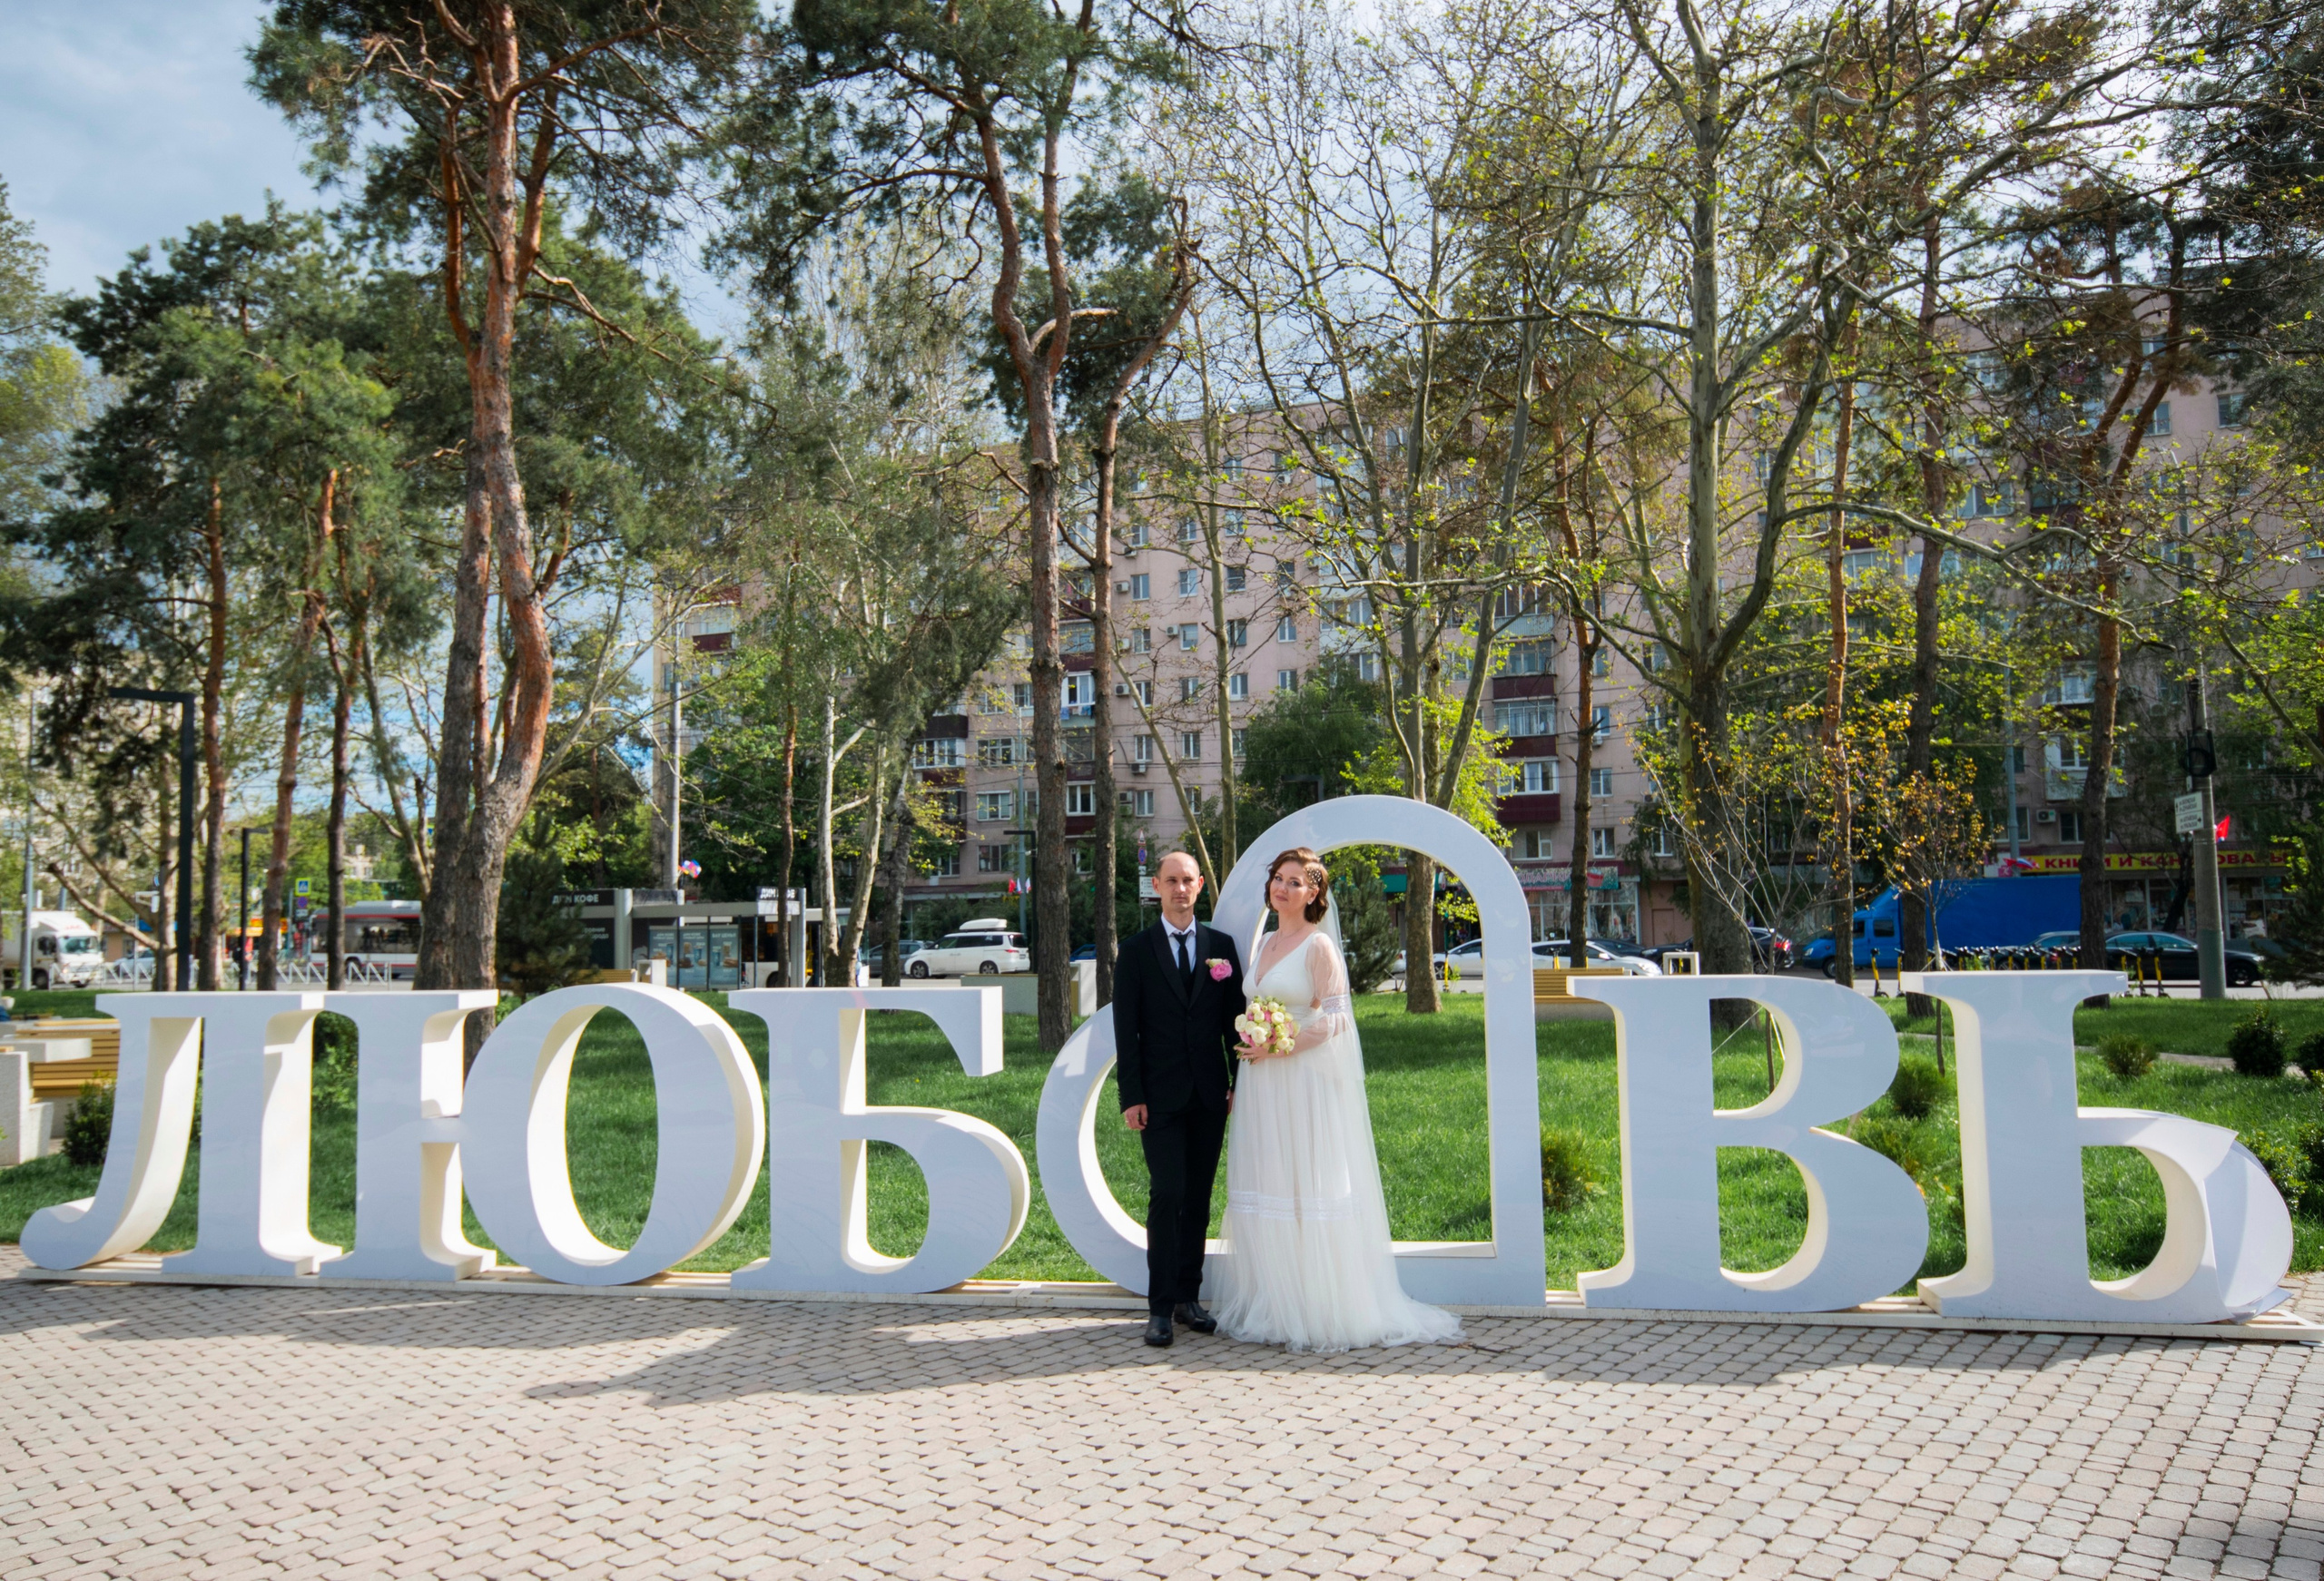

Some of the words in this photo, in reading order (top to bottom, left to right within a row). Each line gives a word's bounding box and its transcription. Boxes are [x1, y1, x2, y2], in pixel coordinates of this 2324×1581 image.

[2119, 856, 2132, 867] И
[1515, 870, 1572, 886] ОДАРКИ
[574, 894, 599, 903] КОФЕ
[20, 793, 2296, 1328] ЛЮБОВЬ
